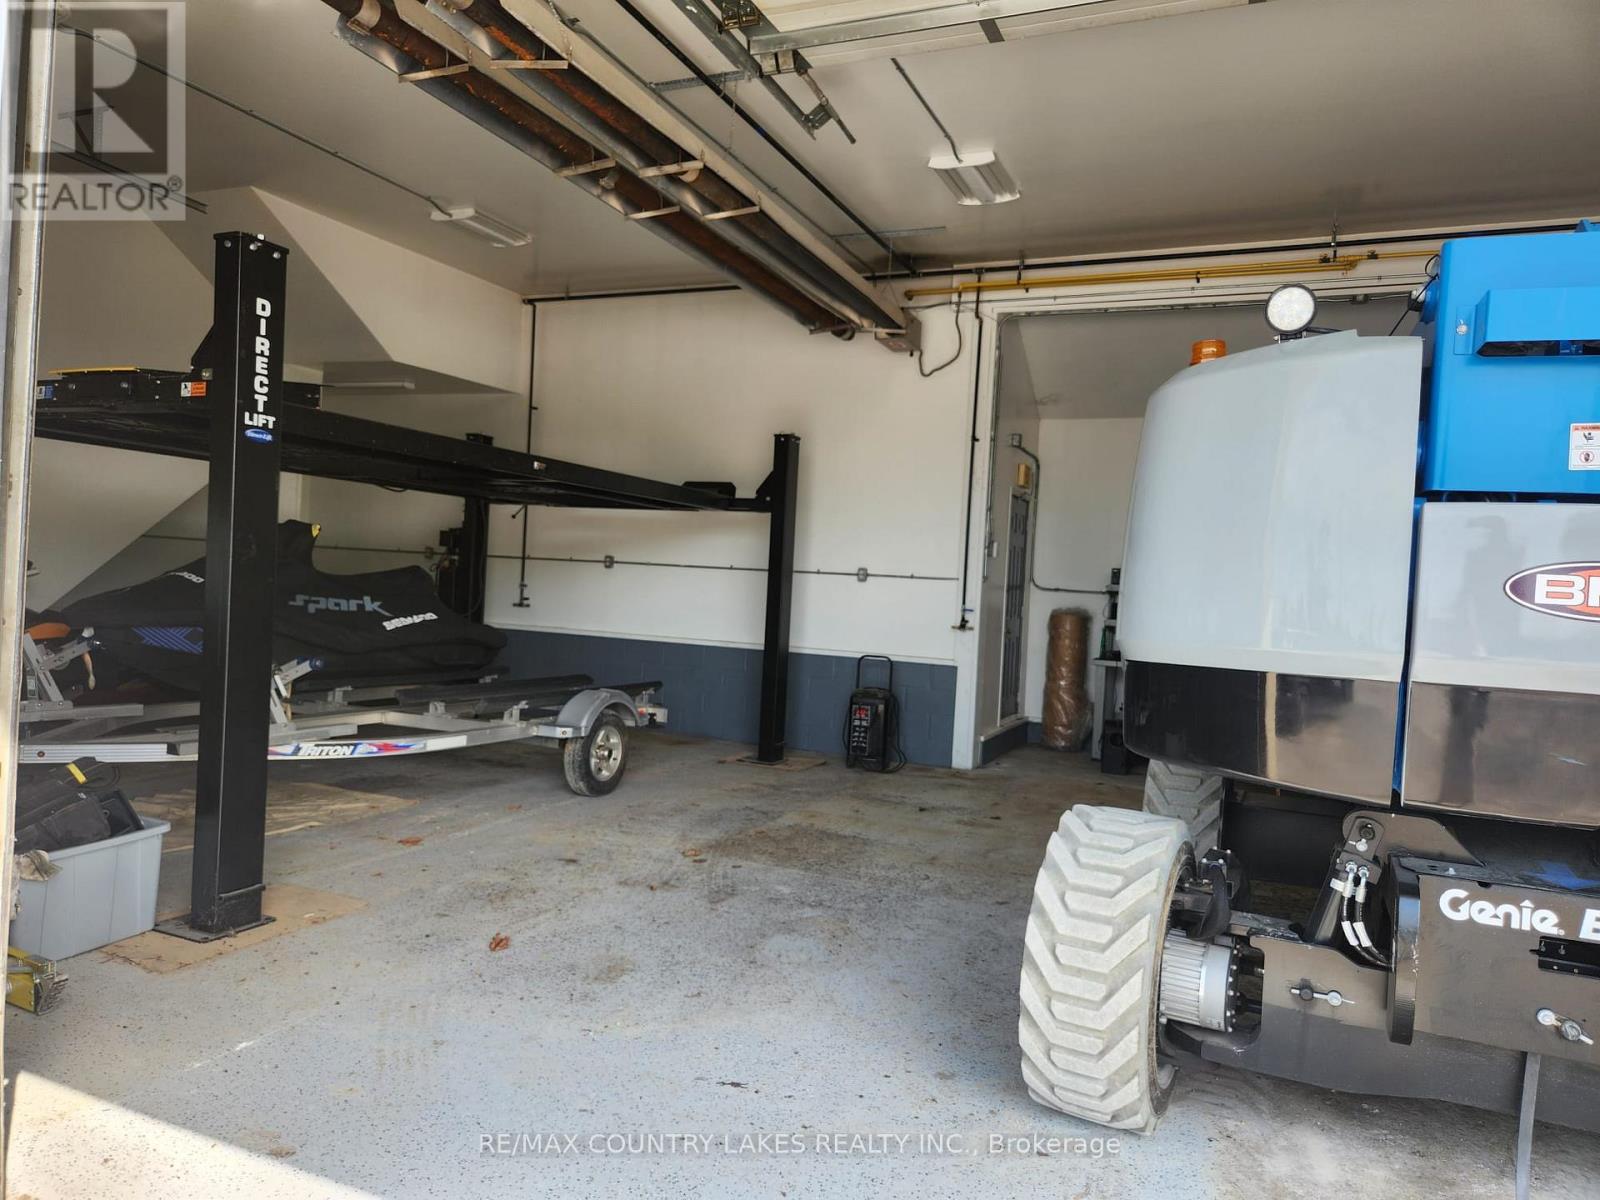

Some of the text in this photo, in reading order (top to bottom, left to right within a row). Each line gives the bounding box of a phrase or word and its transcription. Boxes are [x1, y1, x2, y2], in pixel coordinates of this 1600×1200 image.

[253, 297, 271, 412] DIRECT
[244, 411, 276, 429] LIFT
[288, 594, 394, 616] spark
[298, 743, 355, 756] TRITON
